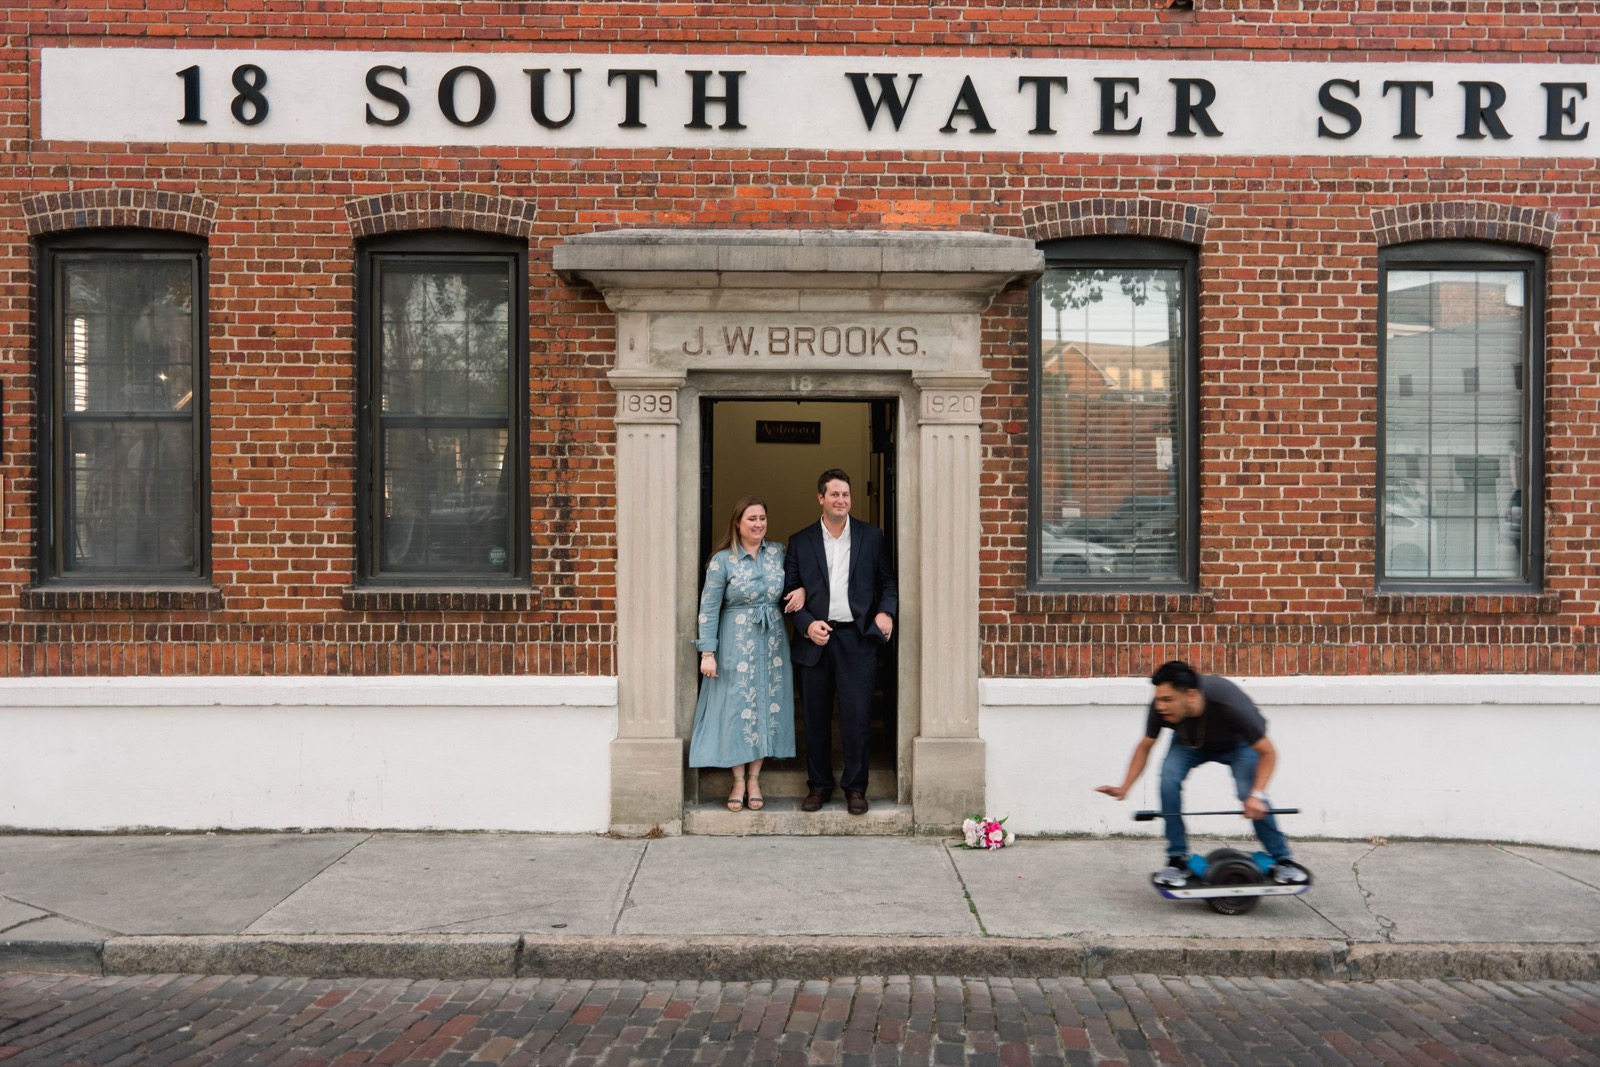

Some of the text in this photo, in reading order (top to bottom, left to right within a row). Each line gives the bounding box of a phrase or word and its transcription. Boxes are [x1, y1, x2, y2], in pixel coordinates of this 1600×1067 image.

[175, 63, 1590, 142] 18 SOUTH WATER STRE
[790, 376, 813, 391] 18
[622, 394, 672, 412] 1899
[926, 395, 975, 413] 1920
